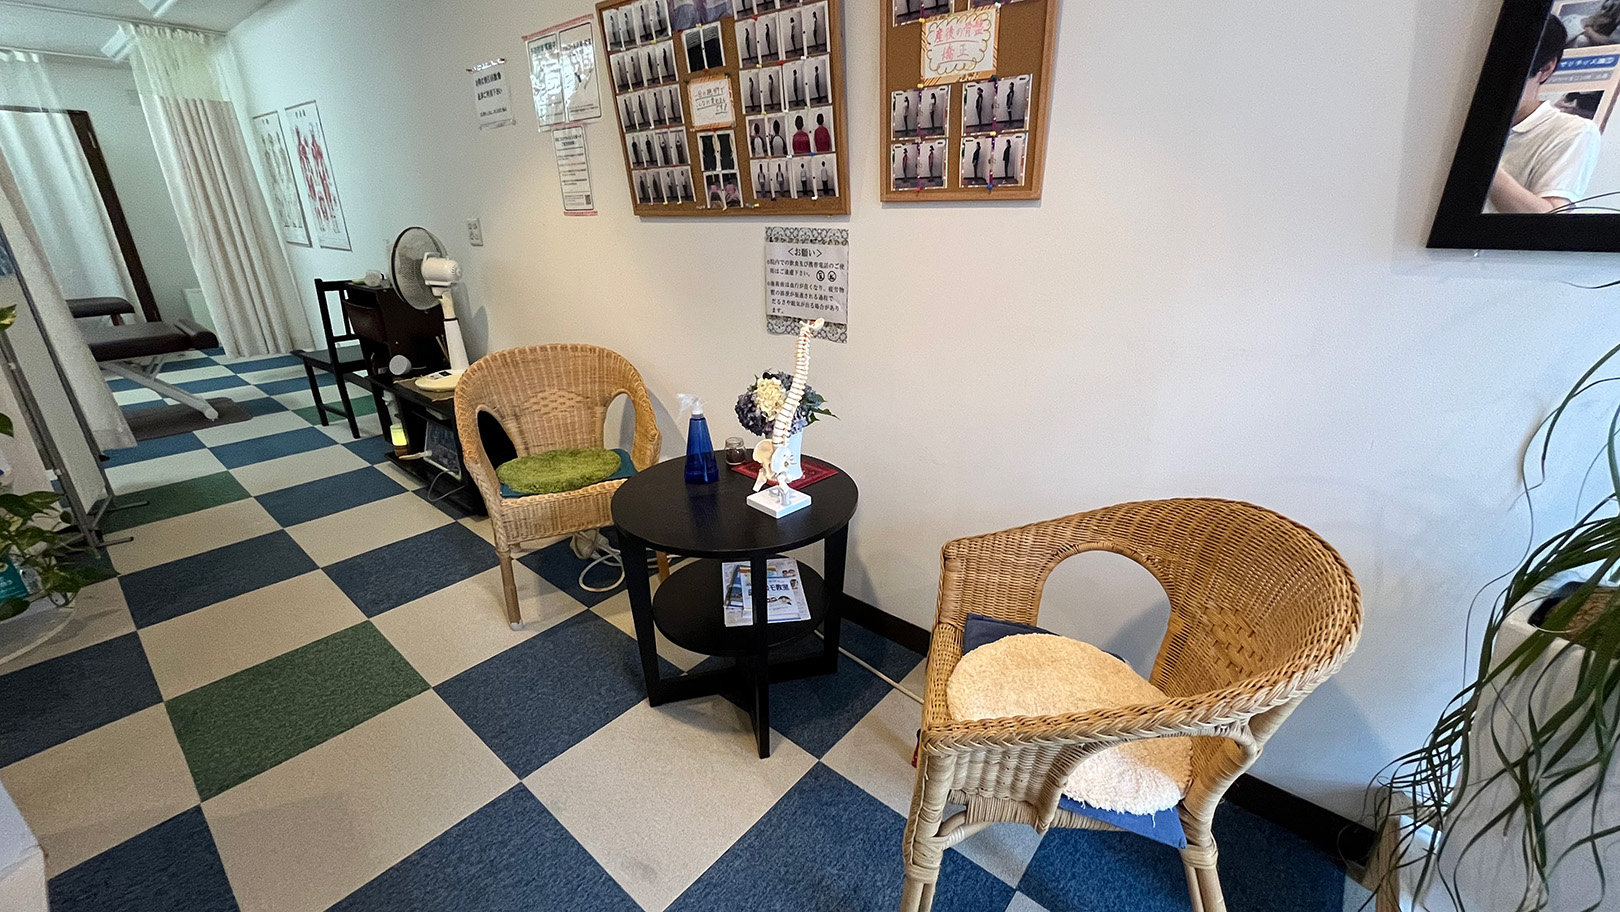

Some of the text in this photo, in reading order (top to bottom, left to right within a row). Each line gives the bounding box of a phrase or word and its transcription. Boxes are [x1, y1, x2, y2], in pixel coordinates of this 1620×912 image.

[934, 18, 984, 43] 産後の骨盤
